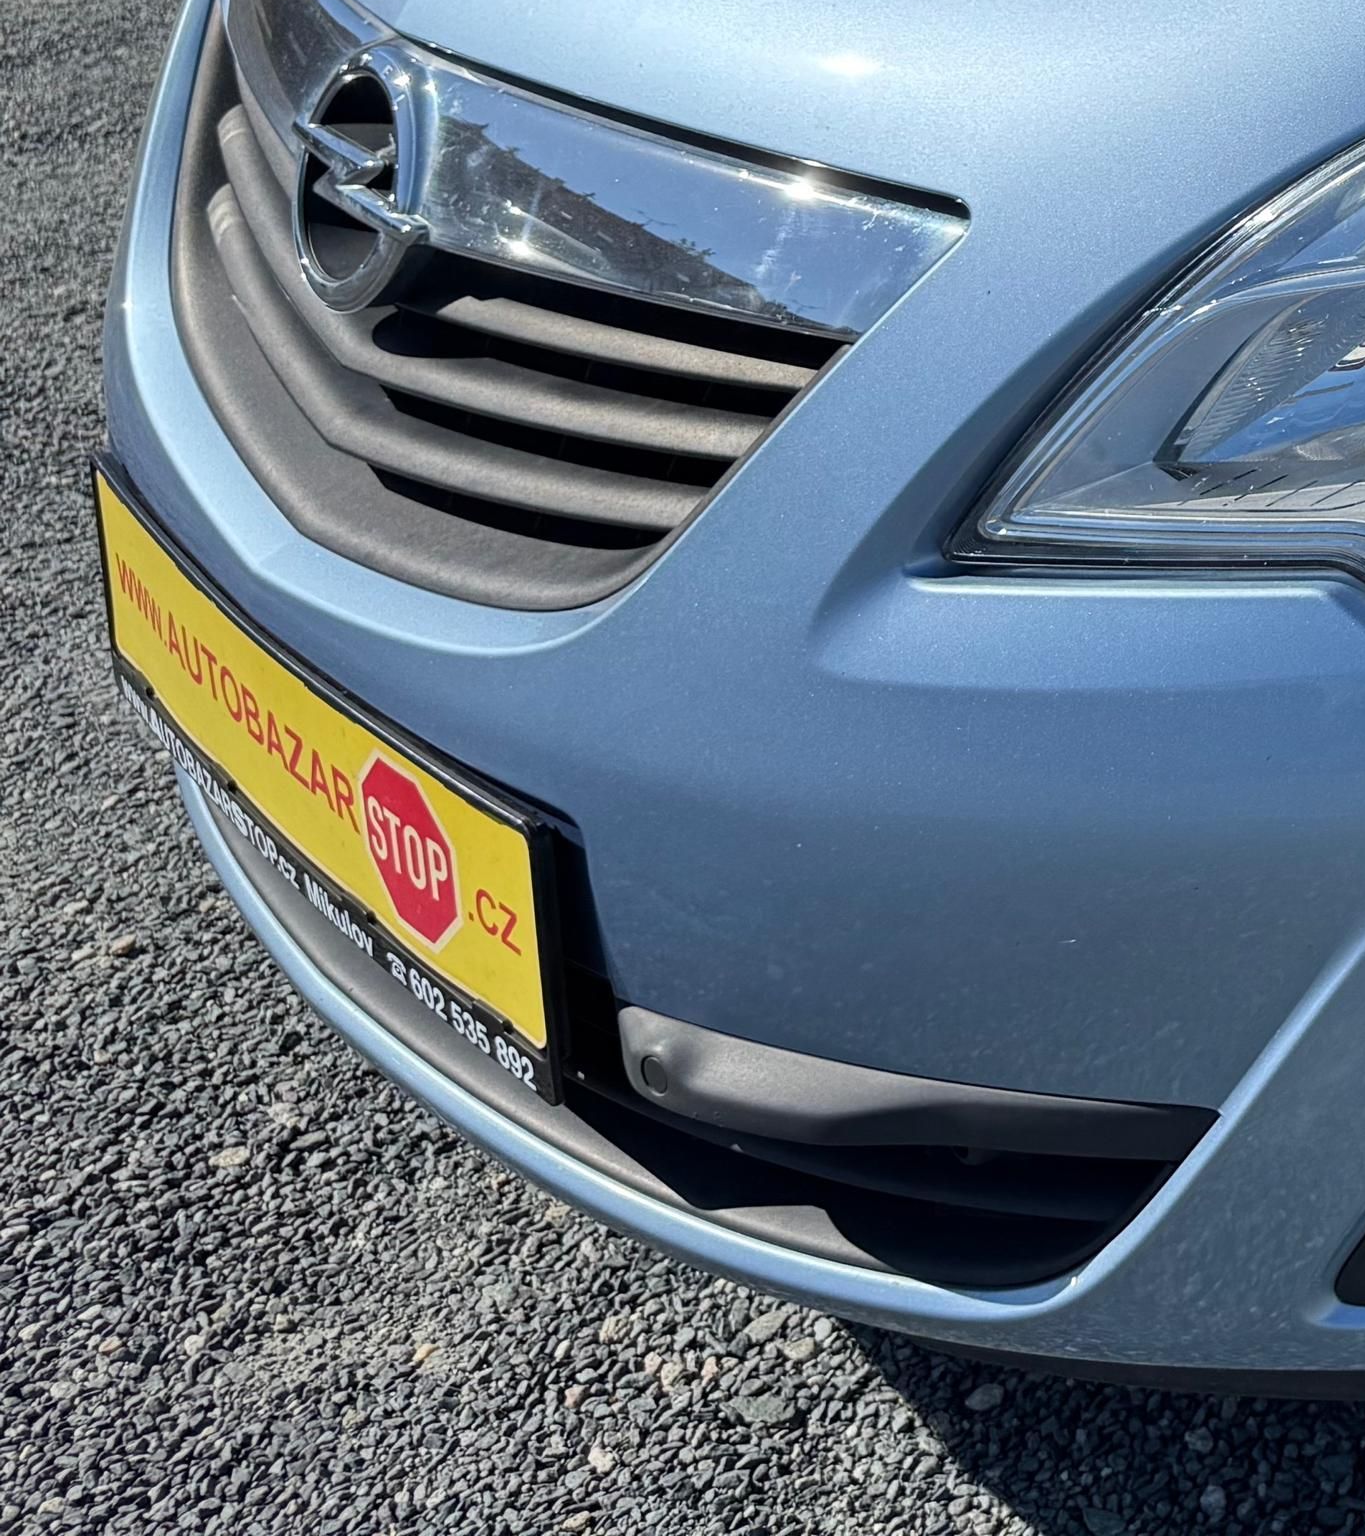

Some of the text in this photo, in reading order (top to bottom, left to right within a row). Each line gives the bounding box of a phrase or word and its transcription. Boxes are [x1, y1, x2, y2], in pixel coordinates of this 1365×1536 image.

[367, 795, 449, 902] STOP
[303, 872, 374, 958] Mikulov
[409, 967, 448, 1022] 602
[450, 1000, 491, 1055] 535
[494, 1035, 537, 1092] 892
